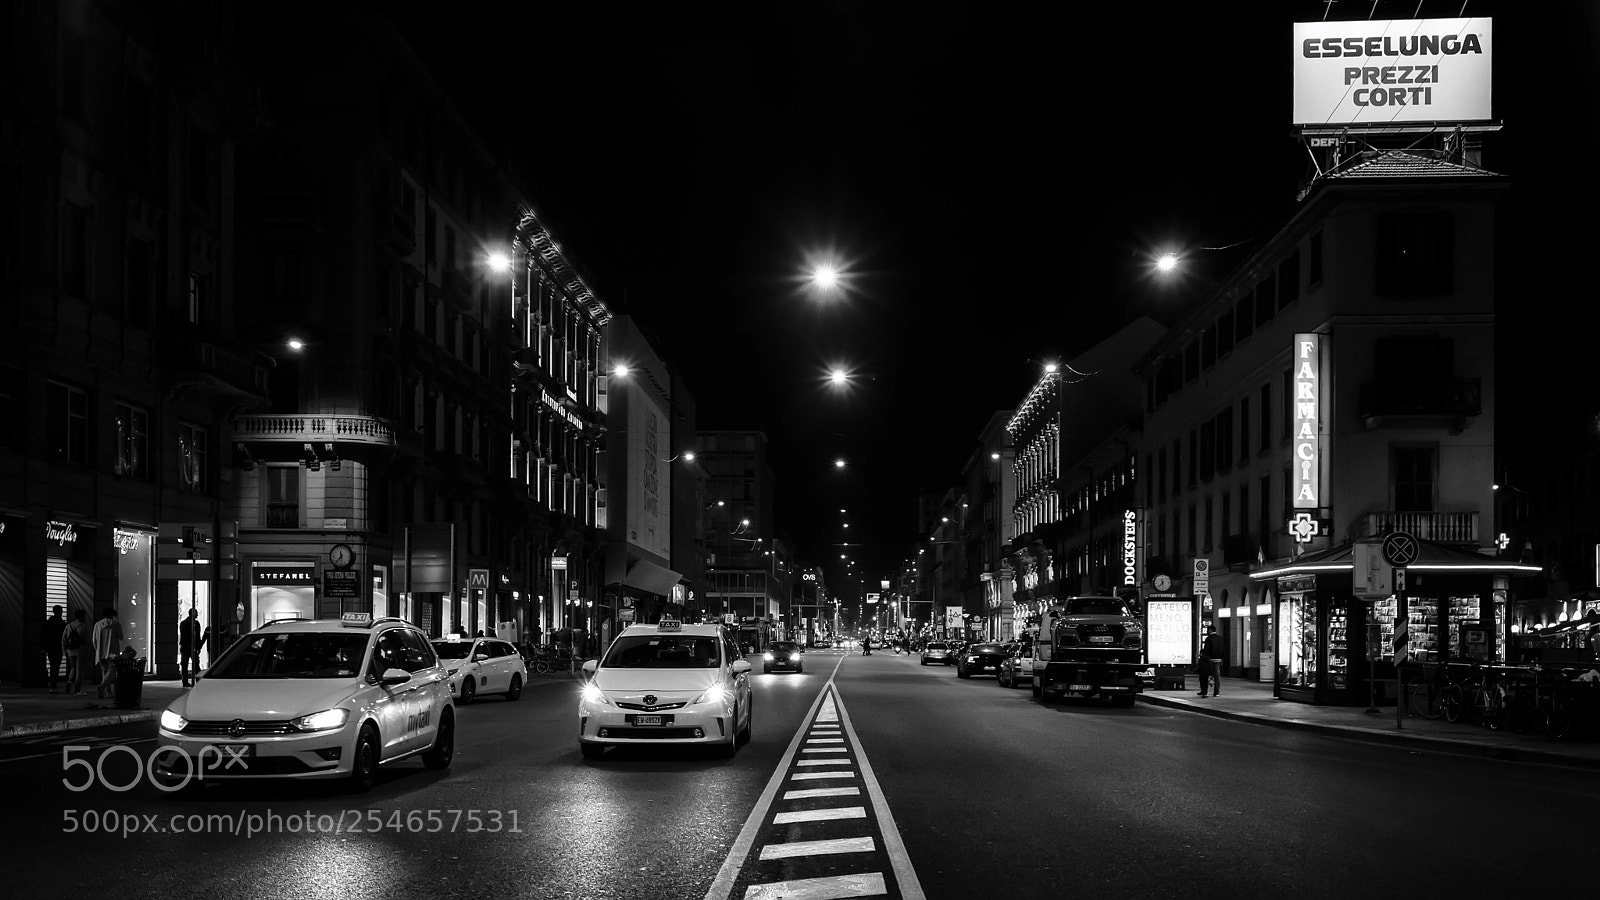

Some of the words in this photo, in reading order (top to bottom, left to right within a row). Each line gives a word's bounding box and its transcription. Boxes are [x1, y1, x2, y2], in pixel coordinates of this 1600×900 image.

[1303, 34, 1482, 58] ESSELUNGA
[1344, 65, 1438, 85] PREZZI
[1353, 87, 1431, 106] CORTI
[1311, 138, 1339, 147] DEFI
[1297, 341, 1316, 500] FARMACIA
[46, 521, 77, 547] Douglas
[1124, 509, 1136, 586] DOCKSTEPS
[472, 574, 486, 585] M
[572, 581, 578, 590] P
[1150, 603, 1190, 611] FATELO
[344, 613, 367, 621] TAXI
[1150, 613, 1184, 622] MENO,
[1150, 624, 1190, 632] FATELO
[408, 706, 431, 737] mytaxi
